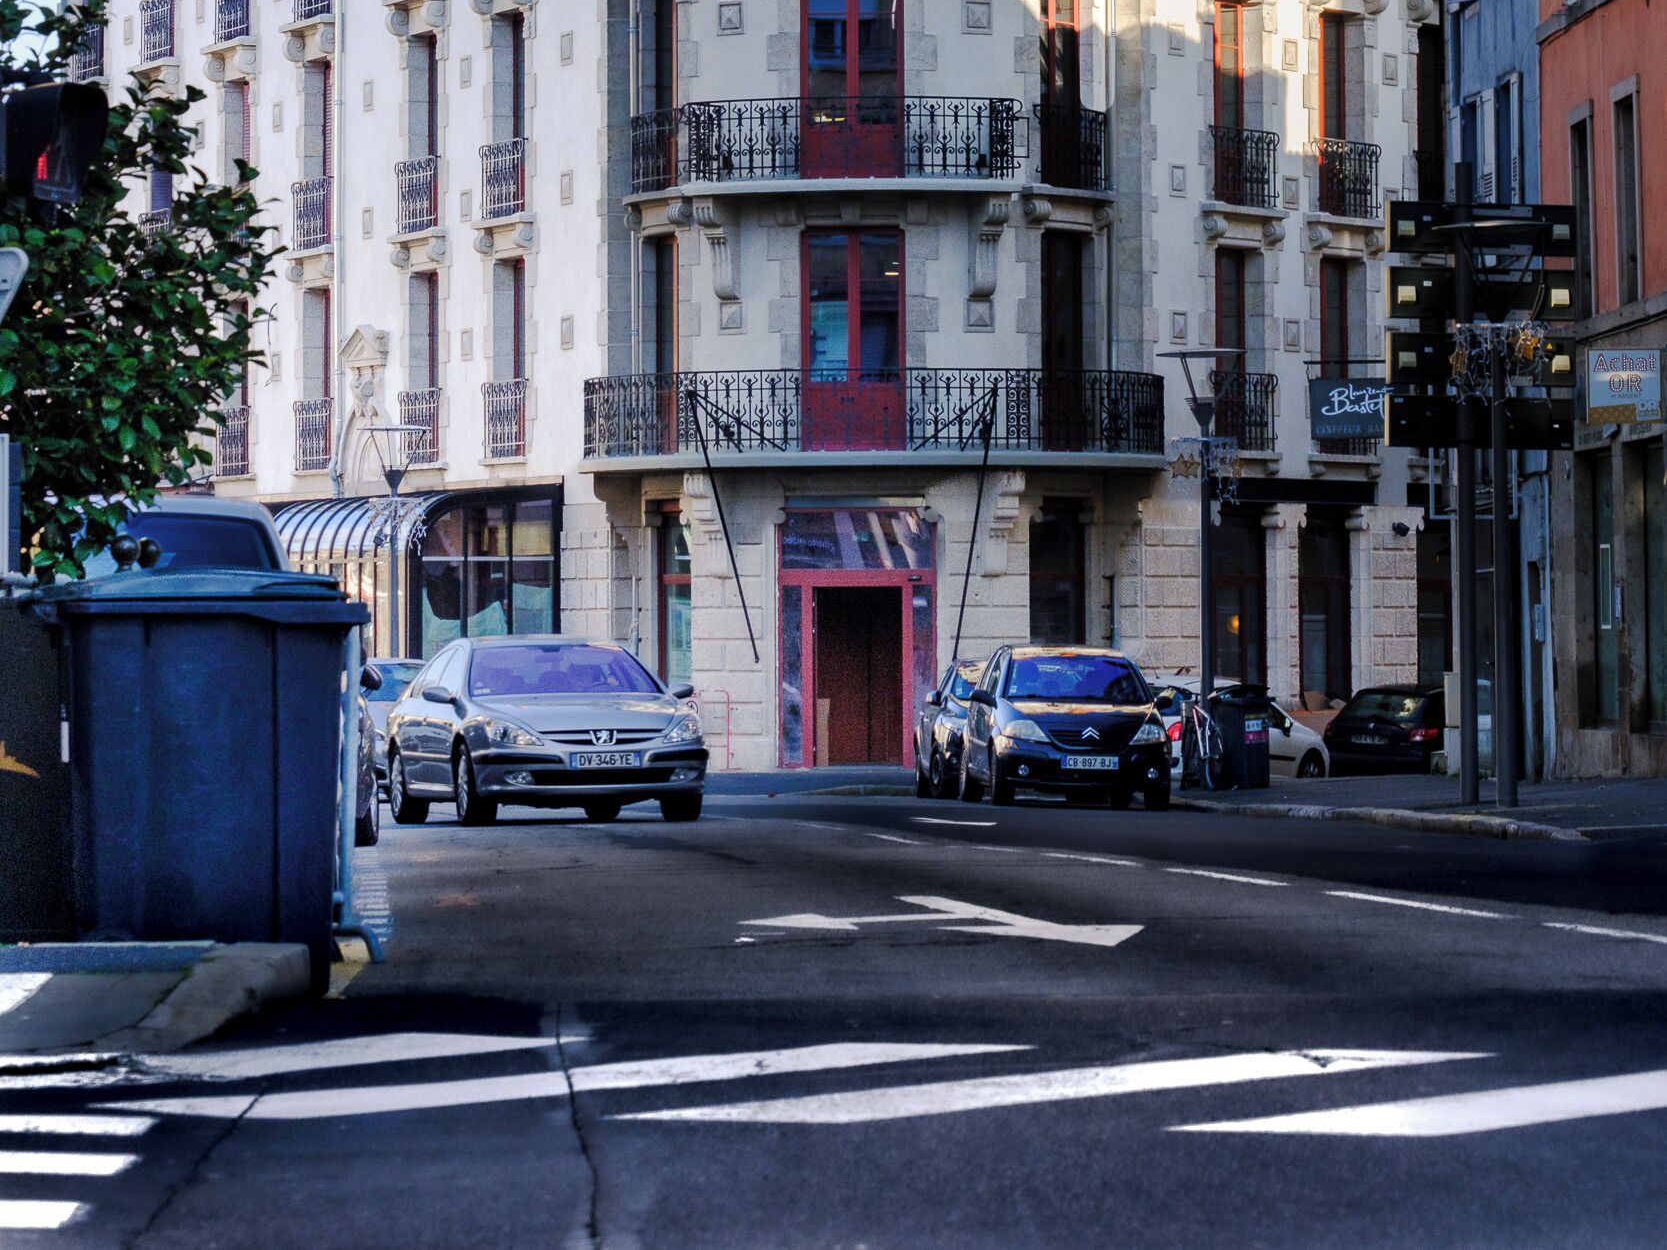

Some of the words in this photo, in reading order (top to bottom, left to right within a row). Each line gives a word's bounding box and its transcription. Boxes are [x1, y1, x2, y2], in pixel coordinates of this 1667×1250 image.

[1594, 353, 1657, 372] Achat
[1609, 374, 1642, 392] OR
[579, 754, 633, 766] DV-346-YE
[1067, 757, 1112, 768] CB-897-BJ
